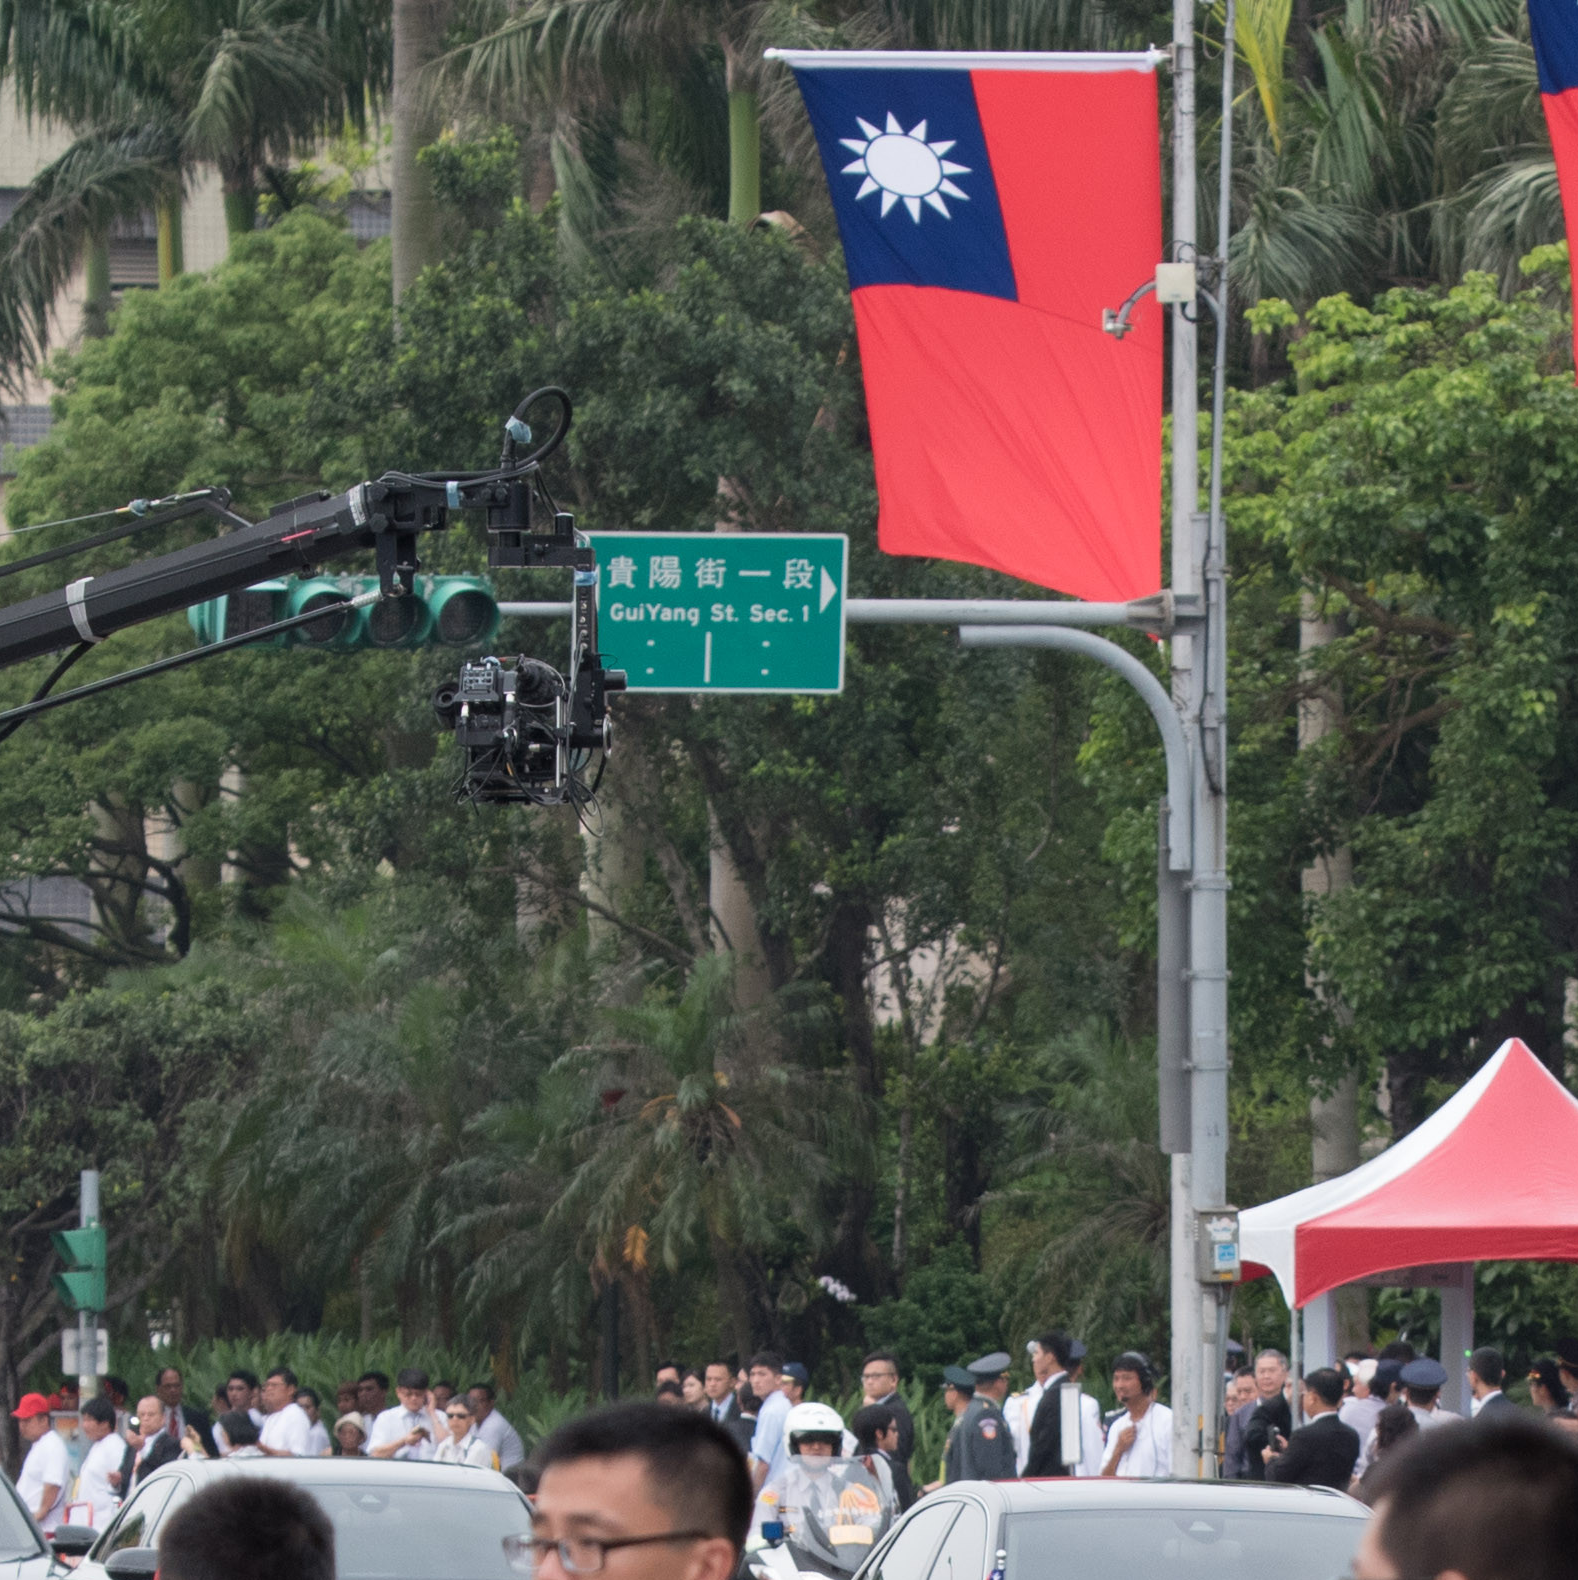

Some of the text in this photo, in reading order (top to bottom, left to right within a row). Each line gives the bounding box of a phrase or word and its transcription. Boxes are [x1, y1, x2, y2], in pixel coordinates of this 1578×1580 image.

[607, 555, 815, 590] 貴陽街一段
[610, 602, 810, 627] GuiYang St. Sec. 1
